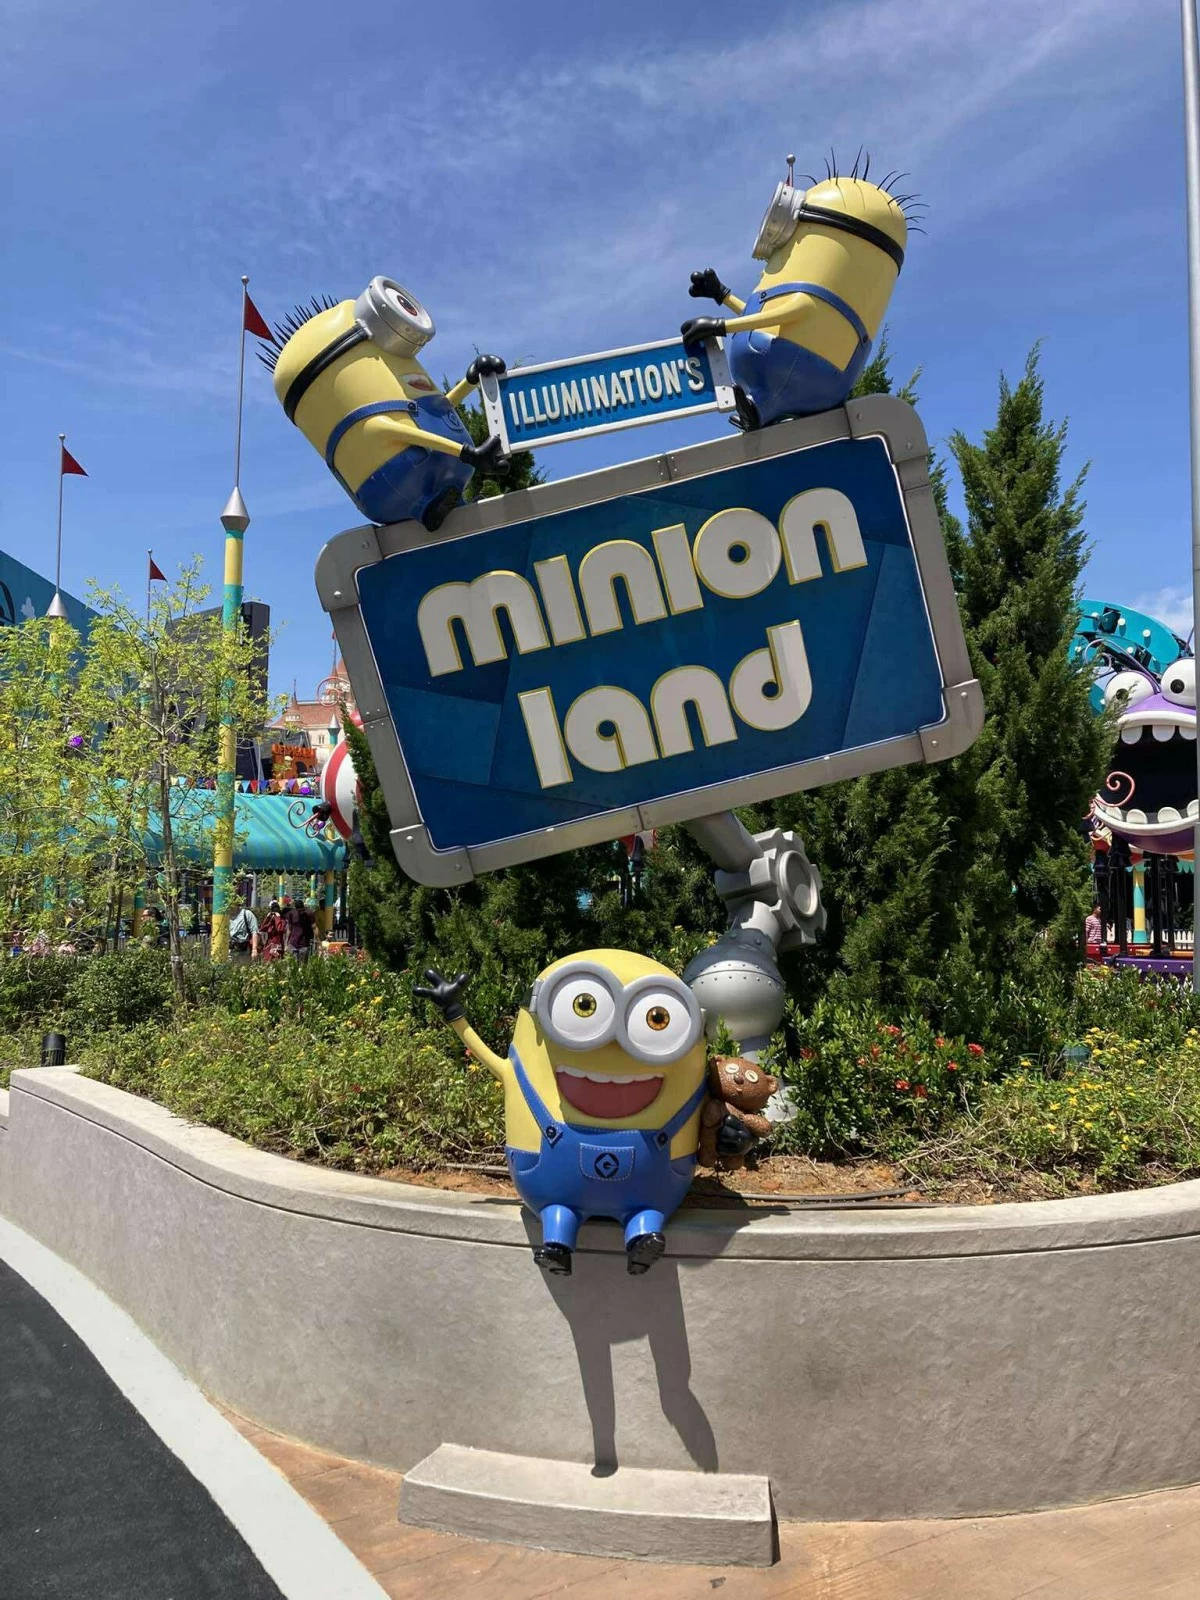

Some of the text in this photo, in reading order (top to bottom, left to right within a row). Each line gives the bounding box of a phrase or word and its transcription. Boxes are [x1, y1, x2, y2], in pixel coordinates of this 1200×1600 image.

[509, 357, 705, 426] ILLUMINATION'S
[417, 487, 868, 677] minion
[517, 620, 812, 788] land
